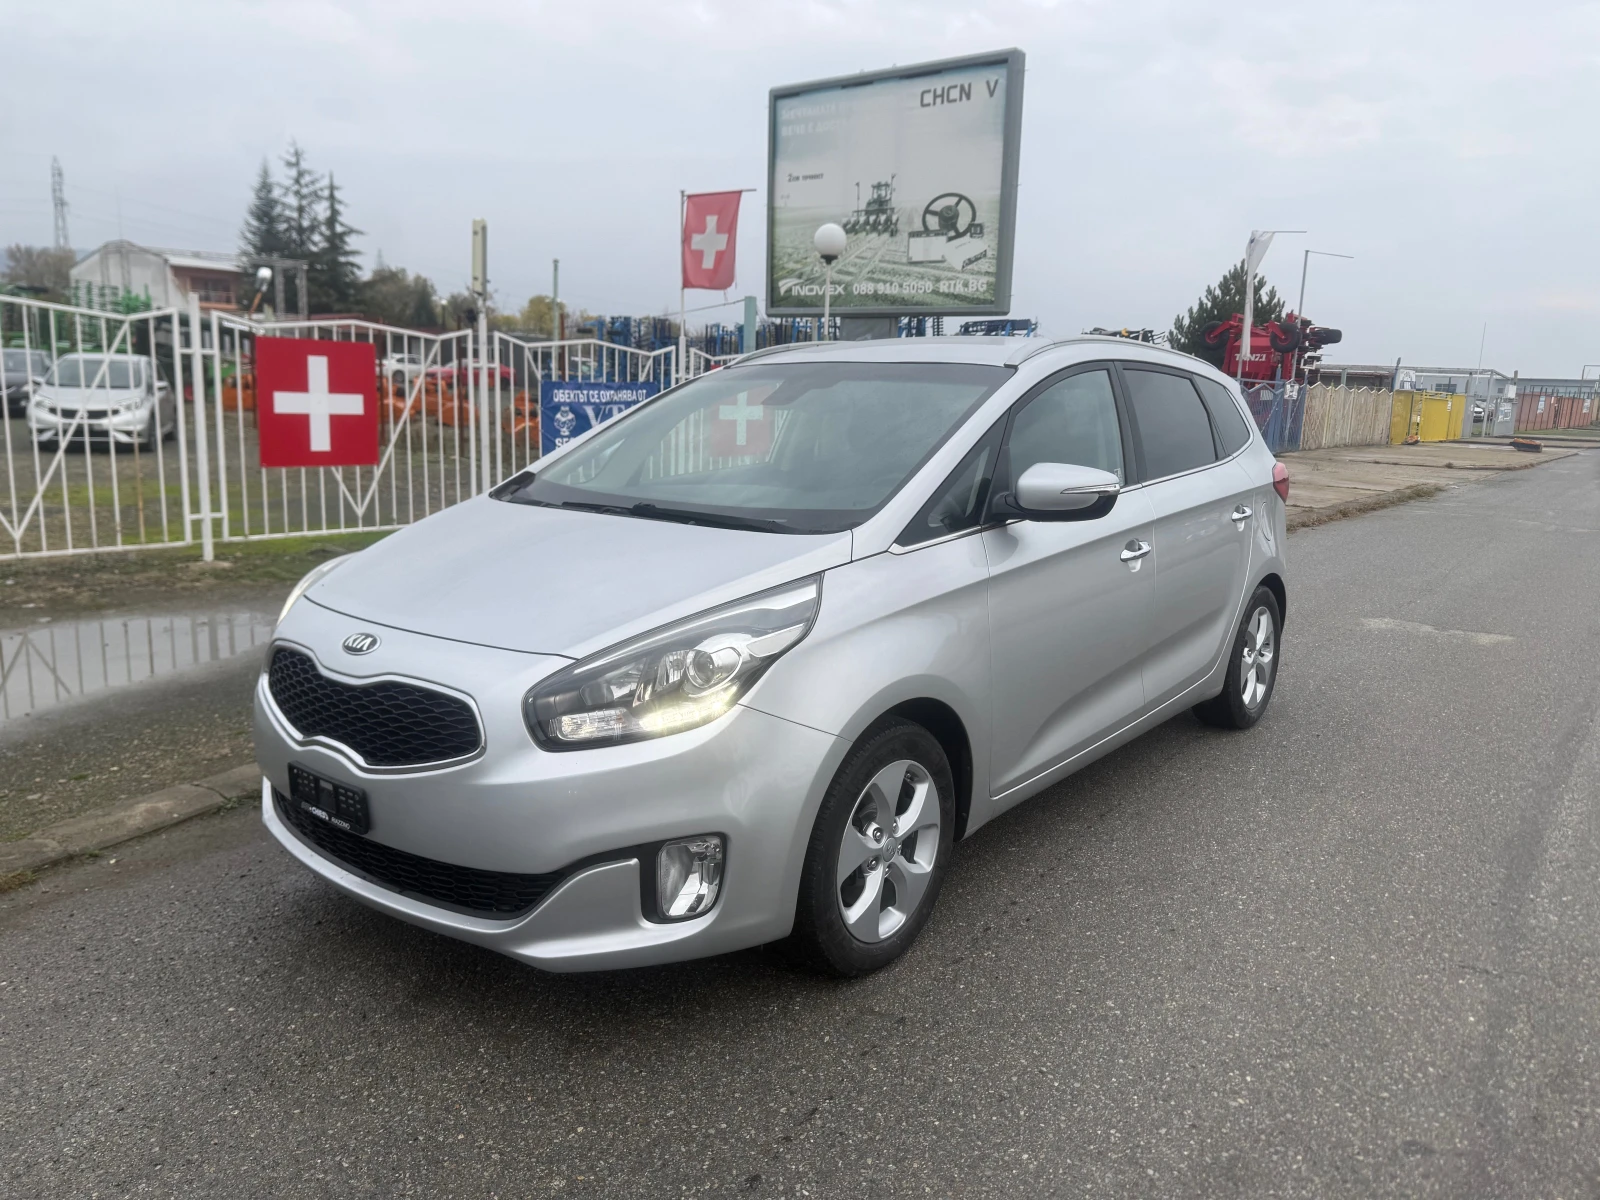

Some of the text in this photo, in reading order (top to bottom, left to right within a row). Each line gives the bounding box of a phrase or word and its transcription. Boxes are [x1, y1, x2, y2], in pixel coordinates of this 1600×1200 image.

[920, 82, 971, 108] CHCN
[792, 279, 988, 296] INOVEX 088 910 5050 RTK.BG
[553, 388, 647, 403] ОБЕКТЪТ СЕ ОХРАНЯВА ОТ
[344, 634, 373, 651] KIA
